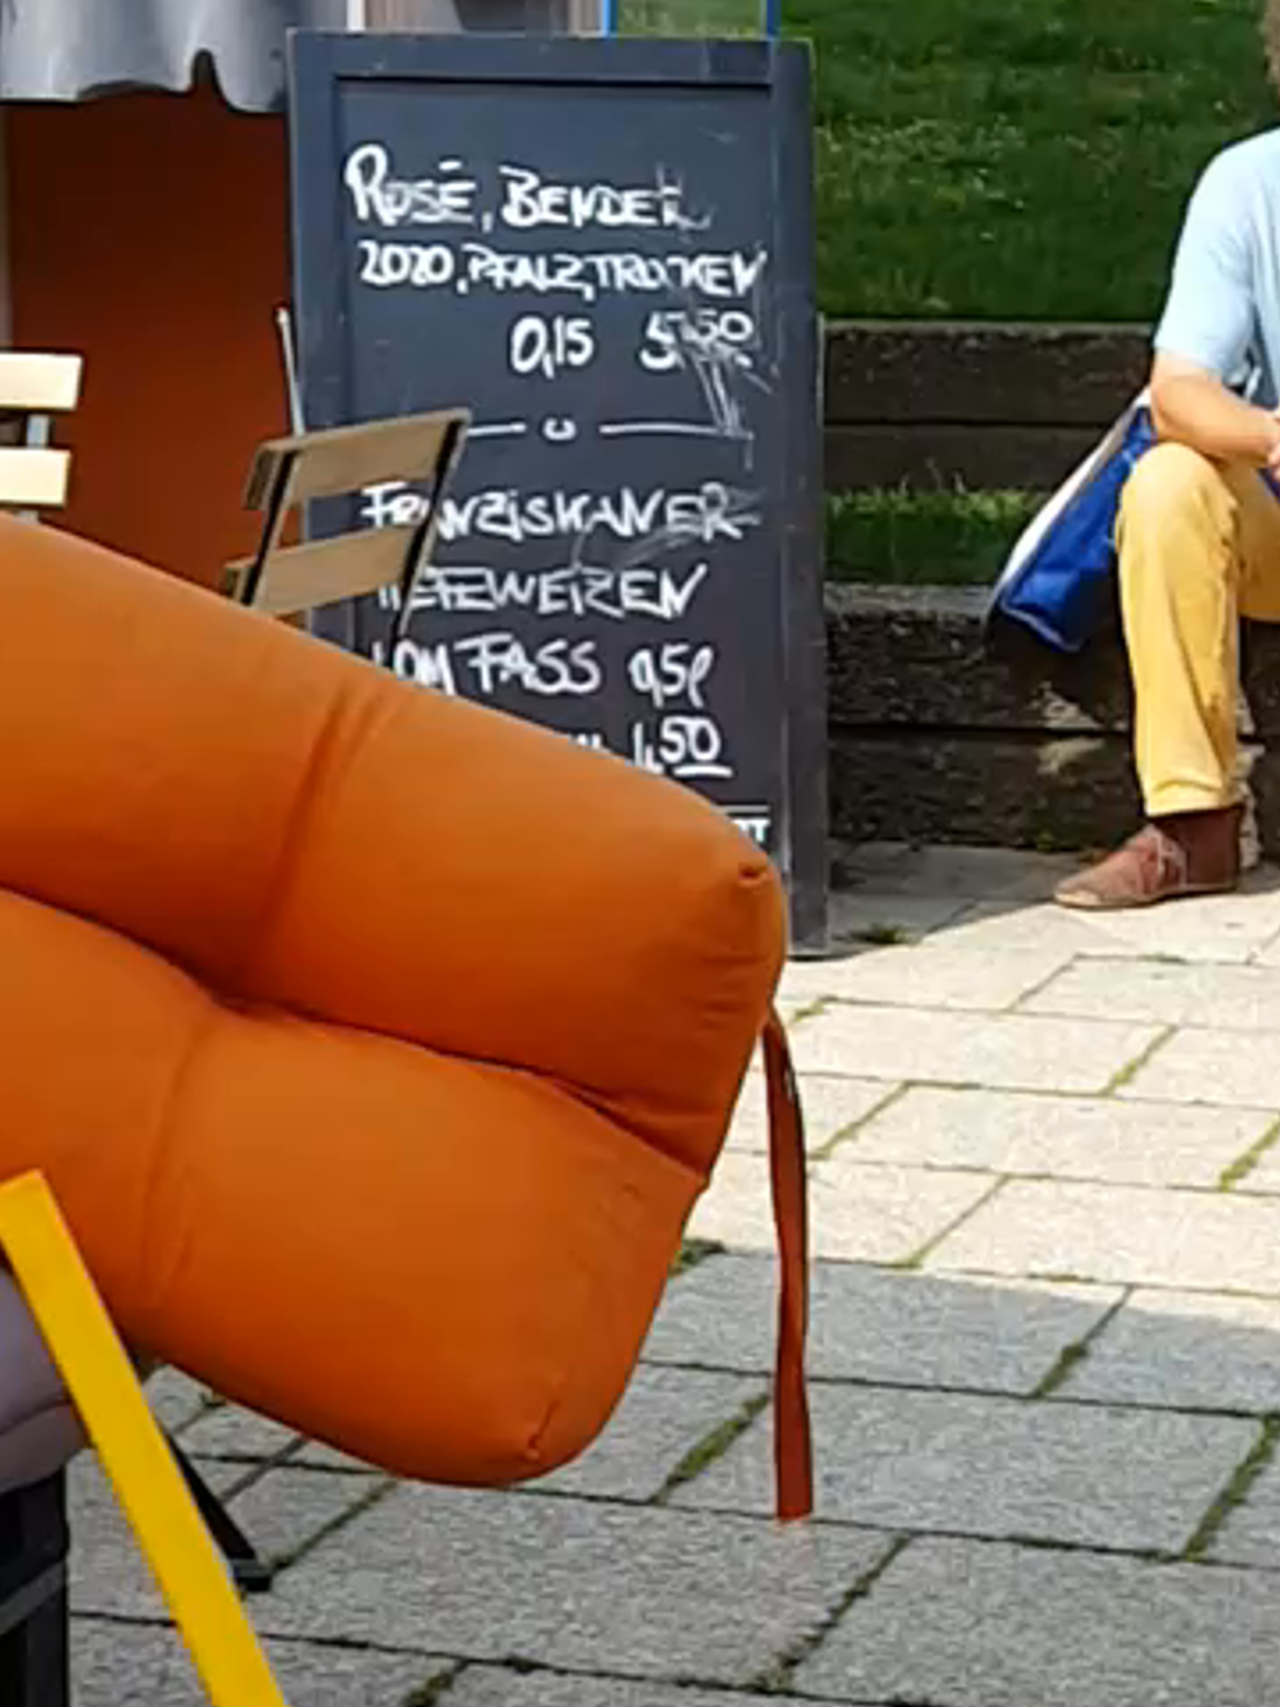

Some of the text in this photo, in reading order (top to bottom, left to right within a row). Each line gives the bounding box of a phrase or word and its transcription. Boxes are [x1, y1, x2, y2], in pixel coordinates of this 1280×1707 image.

[509, 315, 594, 378] 0,15
[373, 640, 457, 696] OM
[454, 633, 602, 693] FASS
